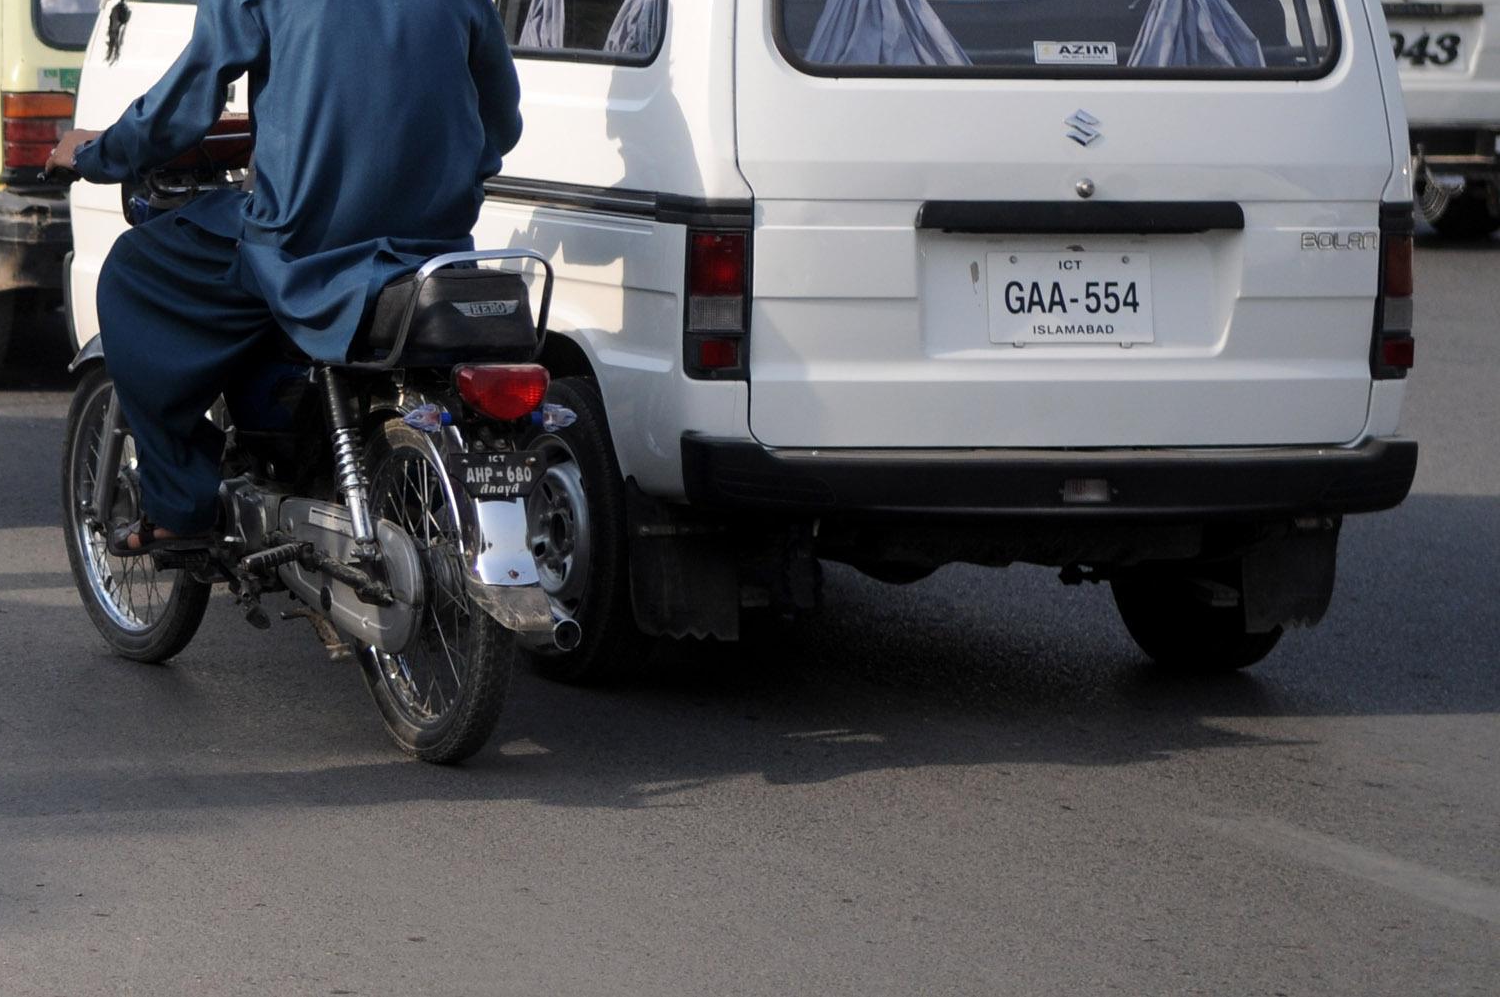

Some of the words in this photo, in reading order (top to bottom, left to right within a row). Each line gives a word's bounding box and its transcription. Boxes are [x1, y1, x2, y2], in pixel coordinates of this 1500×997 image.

[1059, 45, 1109, 55] AZIM
[1058, 260, 1083, 270] ICT
[1004, 280, 1140, 315] GAA-554
[1033, 324, 1115, 335] ISLAMABAD
[488, 454, 506, 463] ICT
